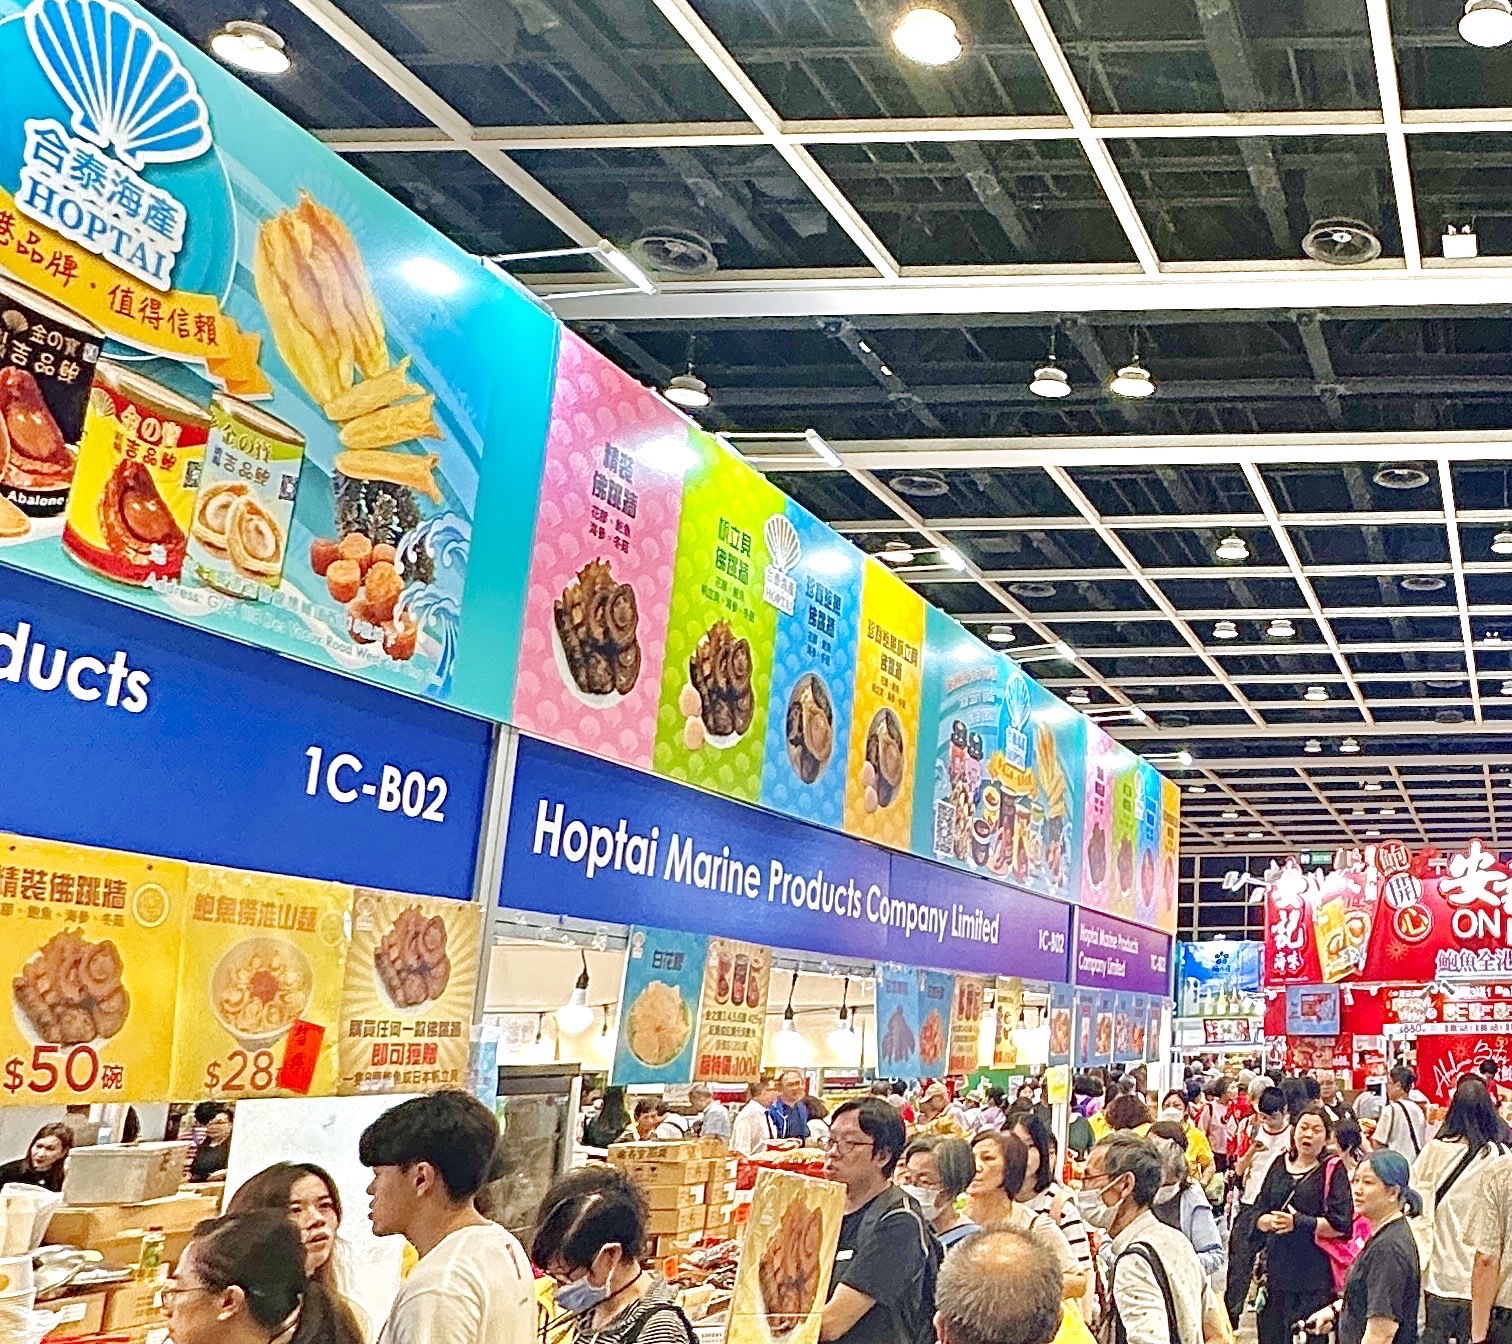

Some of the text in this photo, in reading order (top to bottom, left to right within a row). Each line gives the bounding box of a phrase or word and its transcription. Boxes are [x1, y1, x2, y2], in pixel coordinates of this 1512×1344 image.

[25, 177, 166, 281] HOPTAI
[33, 128, 178, 241] 合泰海產
[305, 745, 448, 823] 1C-B02
[533, 799, 1000, 945] Hoptai Marine Products Company Limited
[1452, 908, 1501, 940] ON
